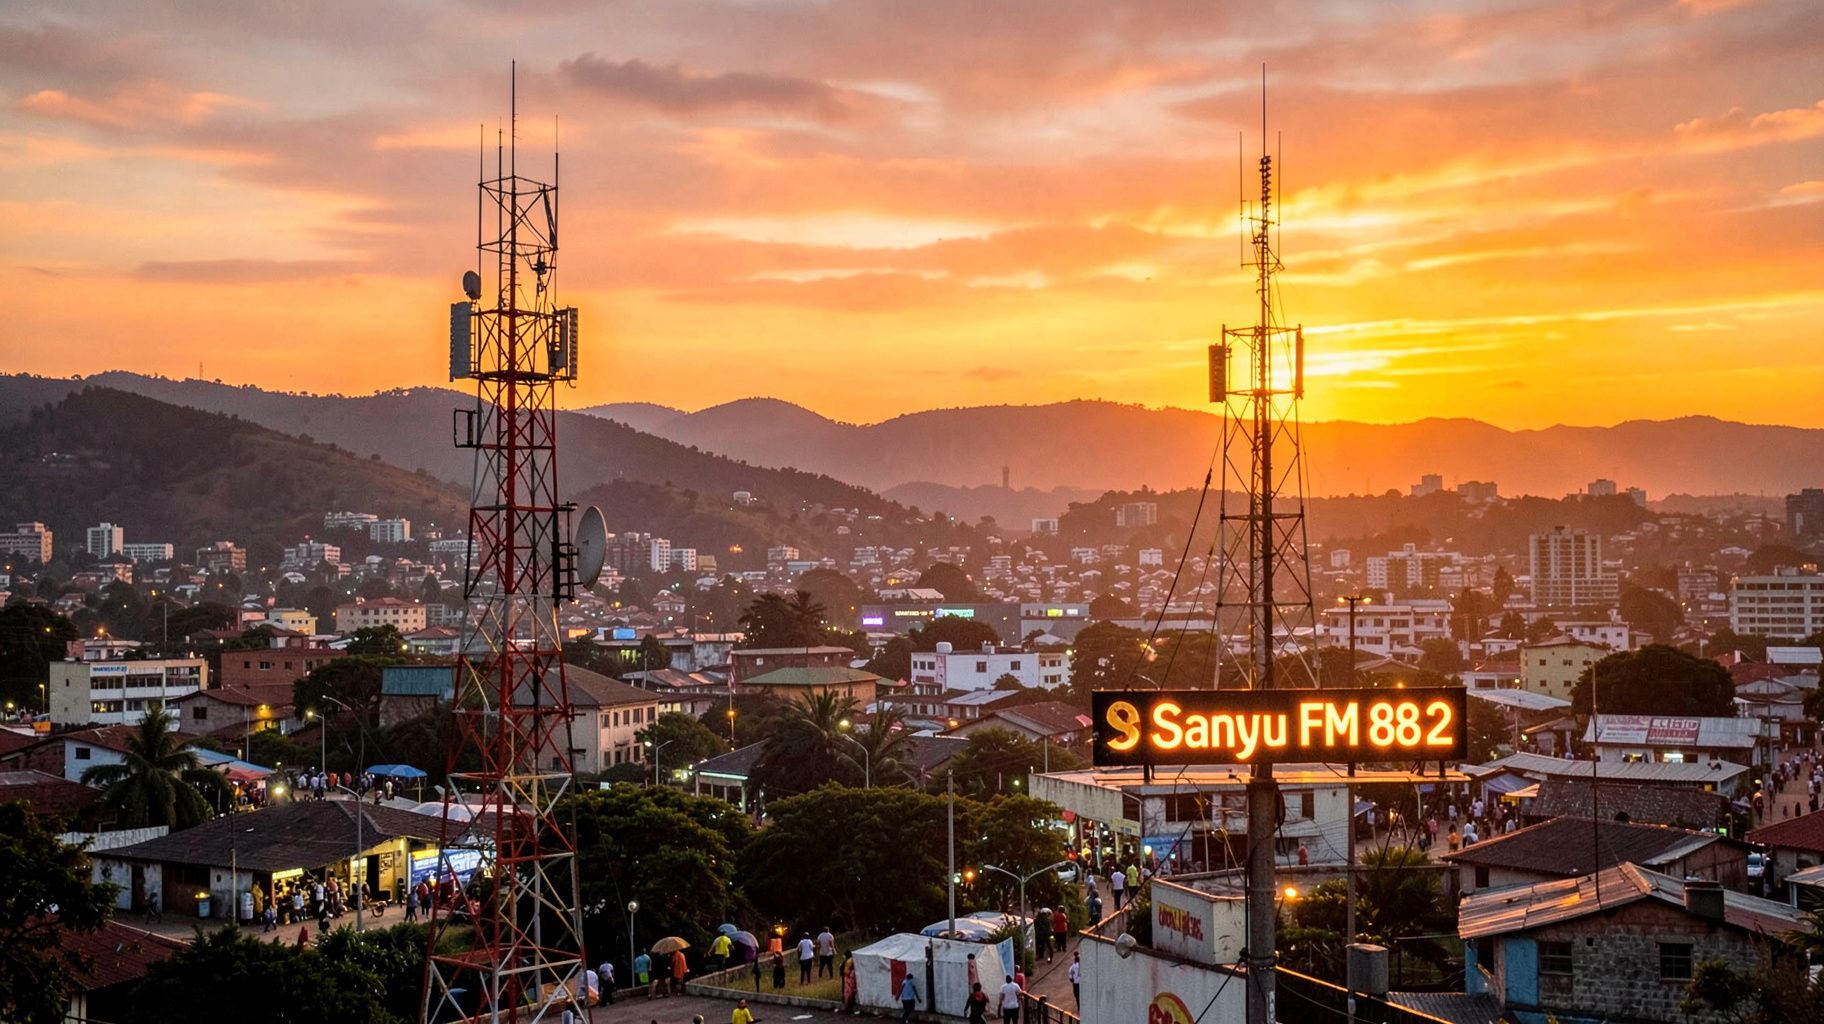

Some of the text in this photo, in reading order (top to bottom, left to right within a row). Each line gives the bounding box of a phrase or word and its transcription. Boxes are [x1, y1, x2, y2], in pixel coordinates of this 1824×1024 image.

[1151, 703, 1287, 760] Sanyu
[1300, 702, 1358, 746] FM
[1369, 702, 1453, 746] 882
